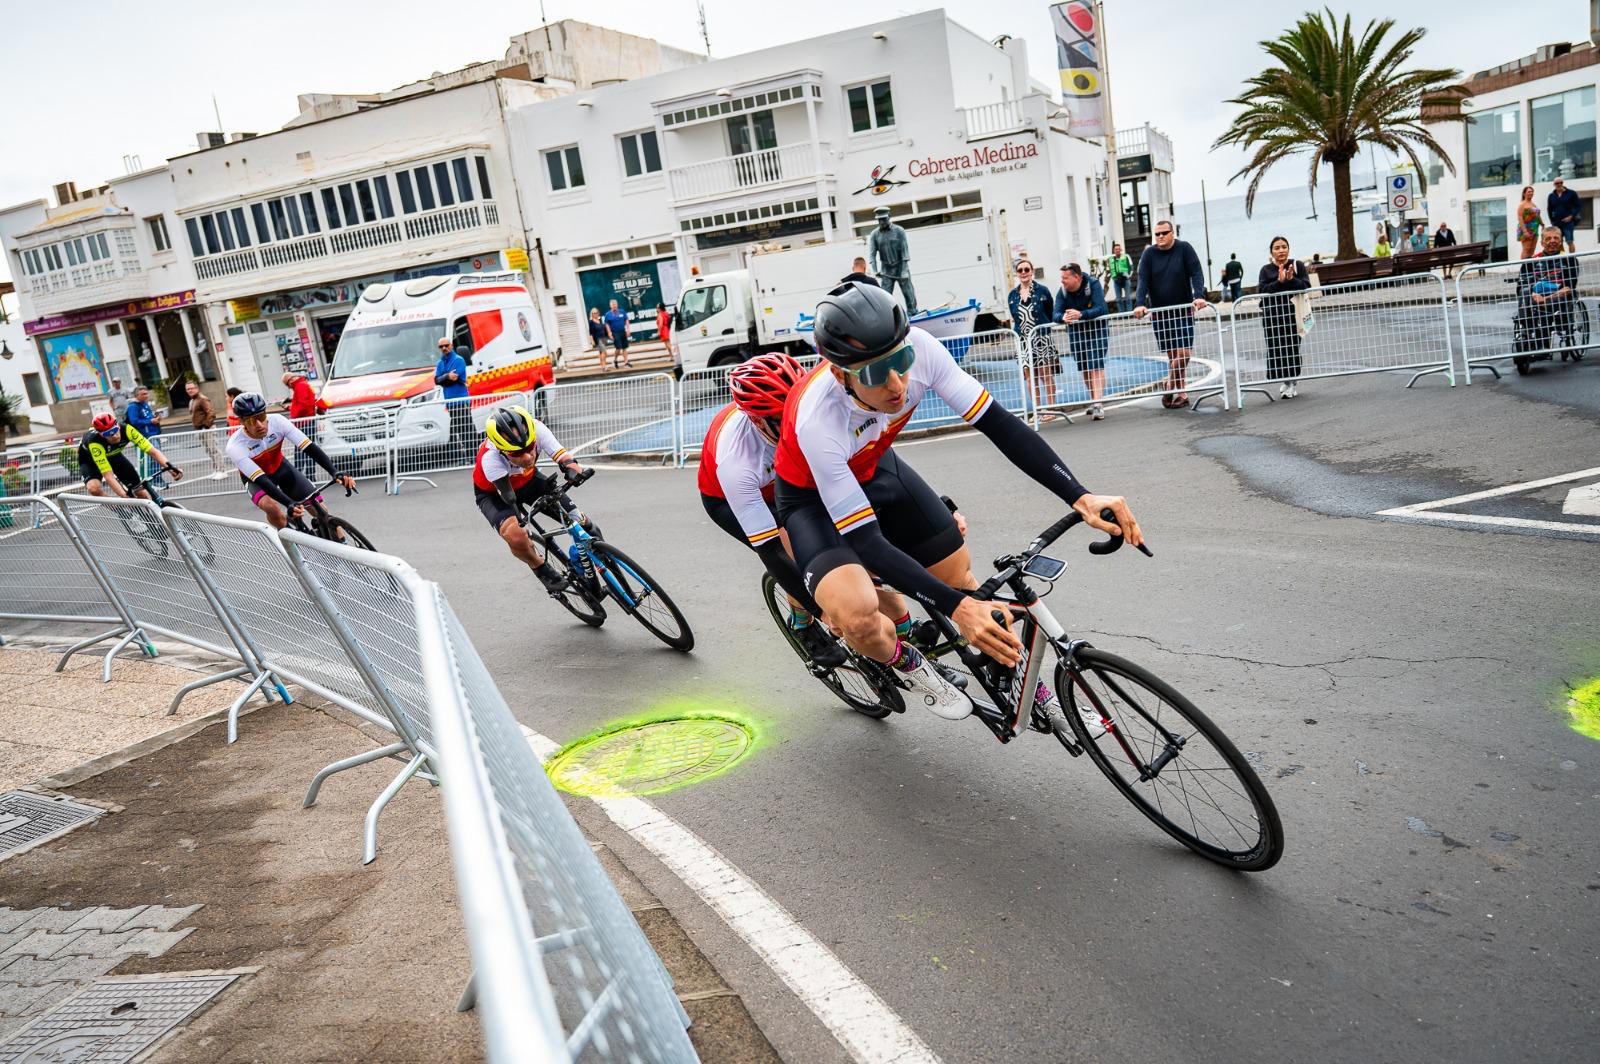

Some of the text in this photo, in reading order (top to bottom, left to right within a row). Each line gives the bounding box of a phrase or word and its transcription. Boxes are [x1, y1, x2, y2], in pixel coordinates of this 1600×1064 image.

[909, 142, 1038, 178] Cabrera Medina
[957, 170, 983, 180] Alquiler
[991, 165, 1007, 174] Rent
[1014, 161, 1028, 169] Car
[612, 277, 653, 289] THE OLD MILL
